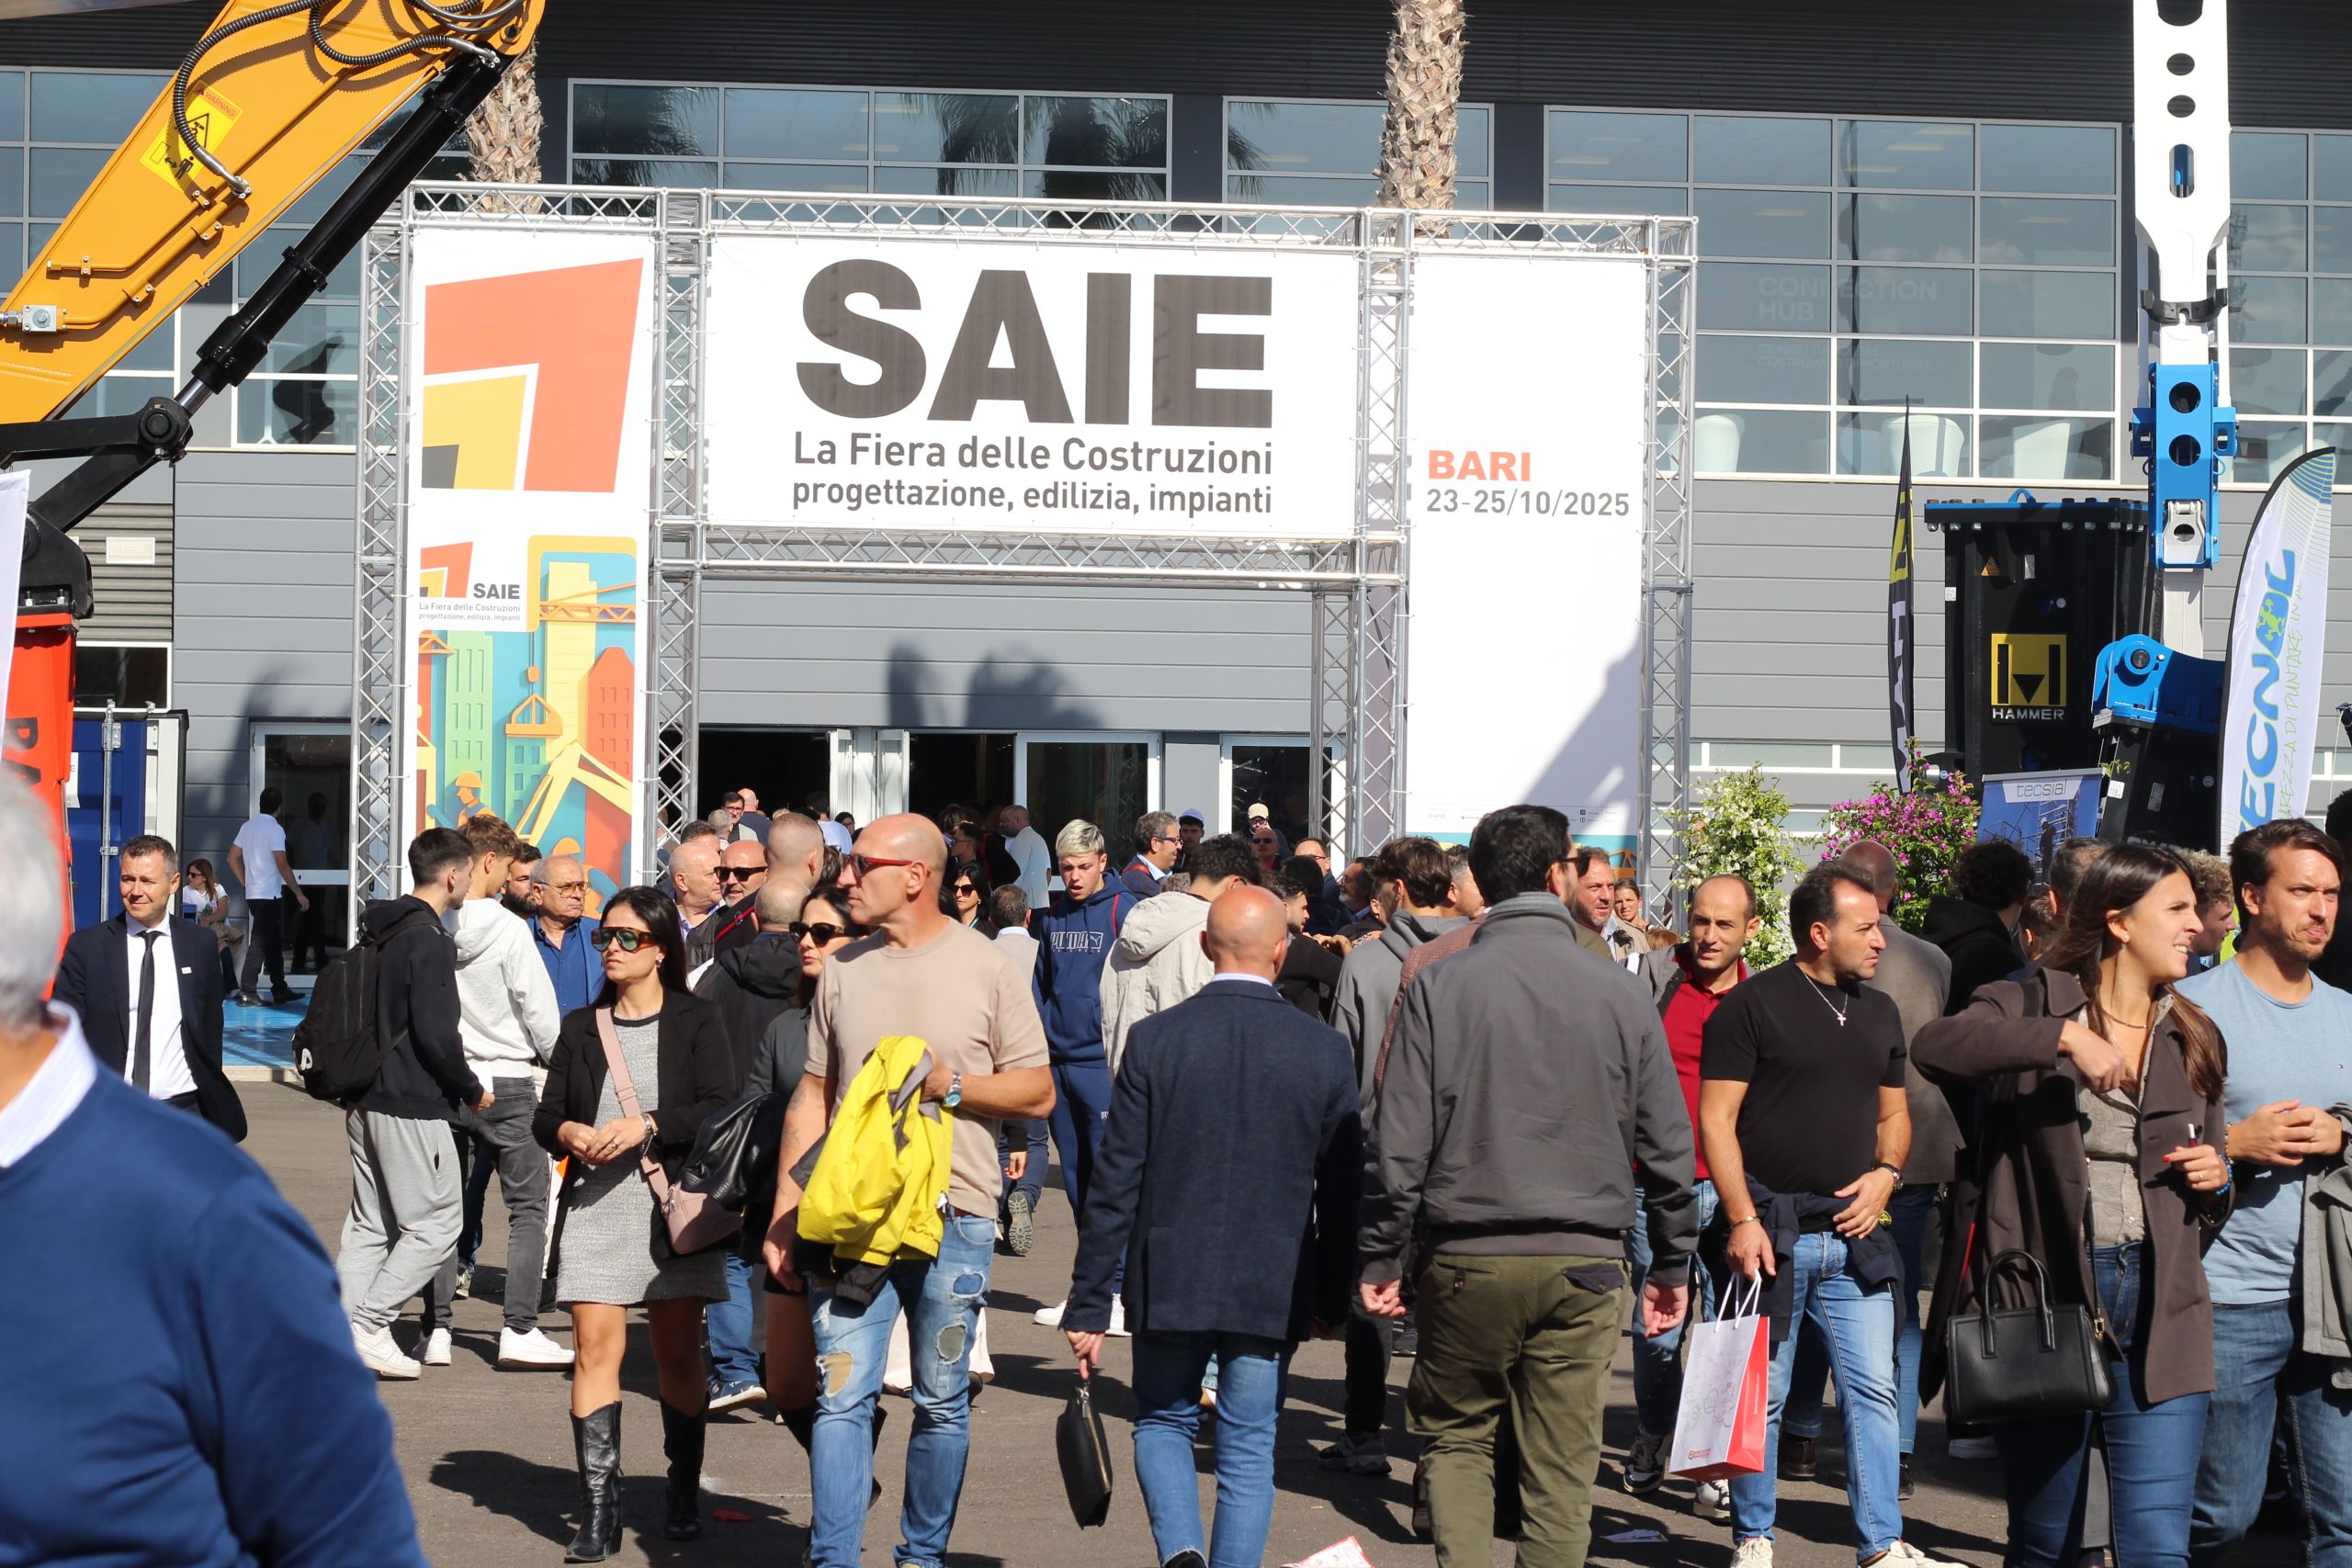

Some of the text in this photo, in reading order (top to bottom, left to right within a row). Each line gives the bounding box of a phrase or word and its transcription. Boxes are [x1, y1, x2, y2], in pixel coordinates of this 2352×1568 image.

[205, 92, 236, 117] WARNING
[1758, 300, 1815, 321] HUB
[796, 259, 1272, 429] SAIE
[796, 432, 1272, 474] La Fiera delle Costruzioni
[1428, 450, 1532, 481] BARI
[794, 479, 1272, 518] progettazione, edilizia, impianti
[1427, 488, 1629, 516] 23-25/10/2025
[473, 583, 520, 600] SAIE
[419, 603, 521, 613] La Fiera delle Costruzioni
[419, 613, 467, 621] progettazione,
[2285, 628, 2303, 709] PUNTARE
[1992, 708, 2064, 720] HAMMER
[2285, 712, 2300, 736] DI
[2017, 778, 2067, 798] tecsial
[1051, 931, 1090, 950] PUMA
